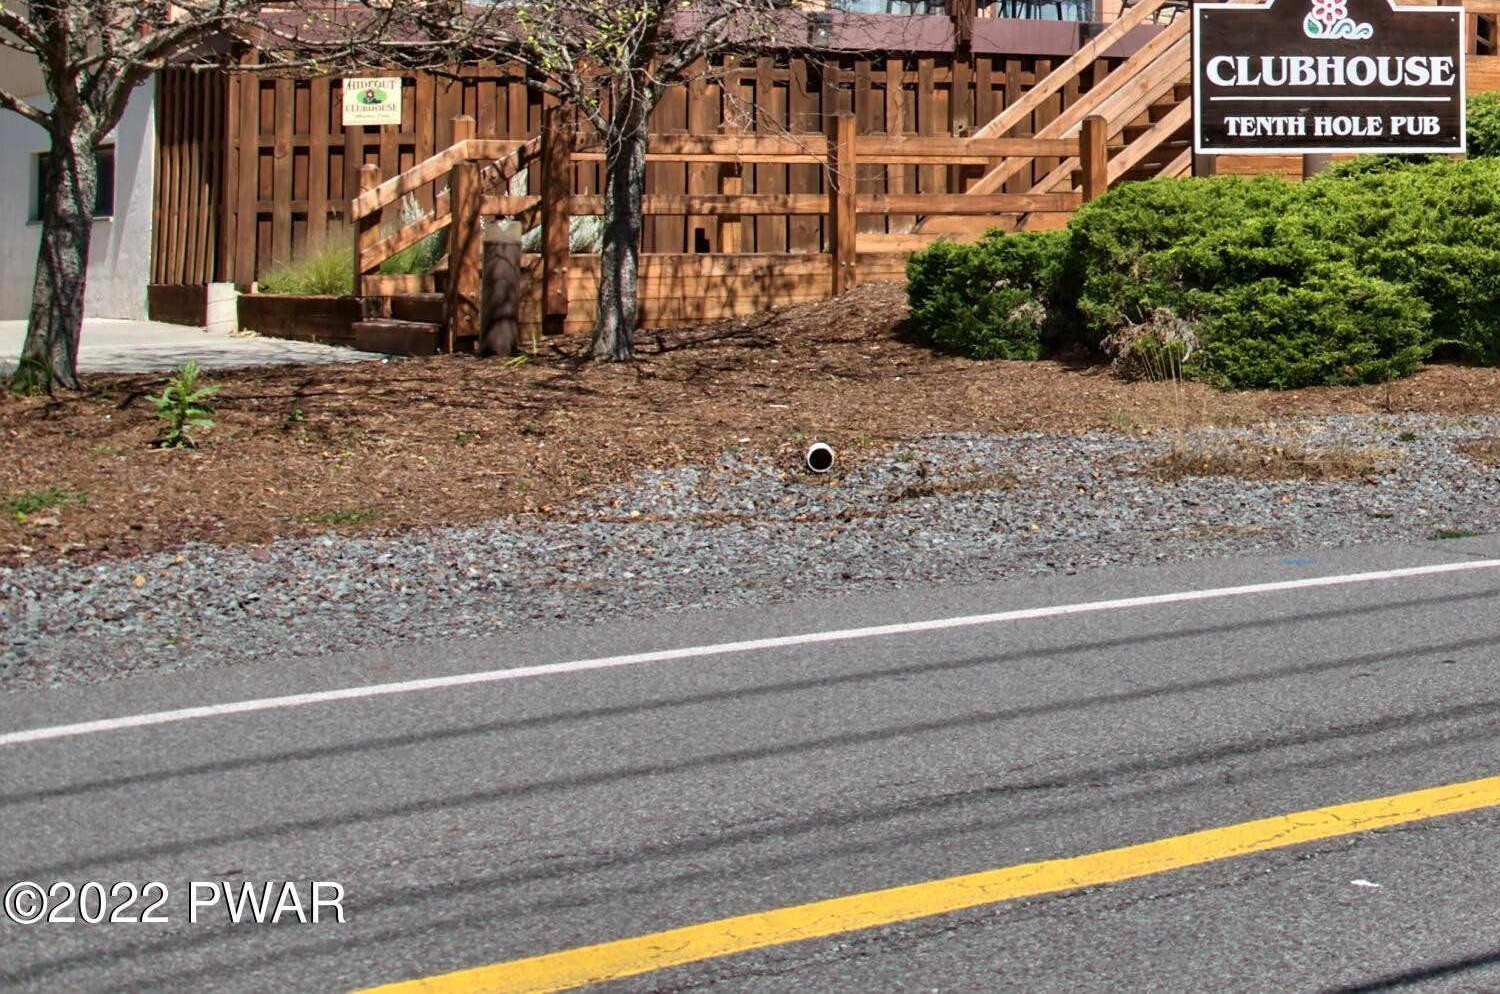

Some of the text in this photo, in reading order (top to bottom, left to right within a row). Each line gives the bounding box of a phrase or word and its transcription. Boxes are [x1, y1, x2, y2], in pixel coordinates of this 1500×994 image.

[1205, 55, 1456, 87] CLUBHOUSE
[348, 79, 395, 91] HIDEOUT
[345, 103, 399, 113] CLUBHOUSE
[1224, 116, 1441, 137] TENTH HOLE PUB
